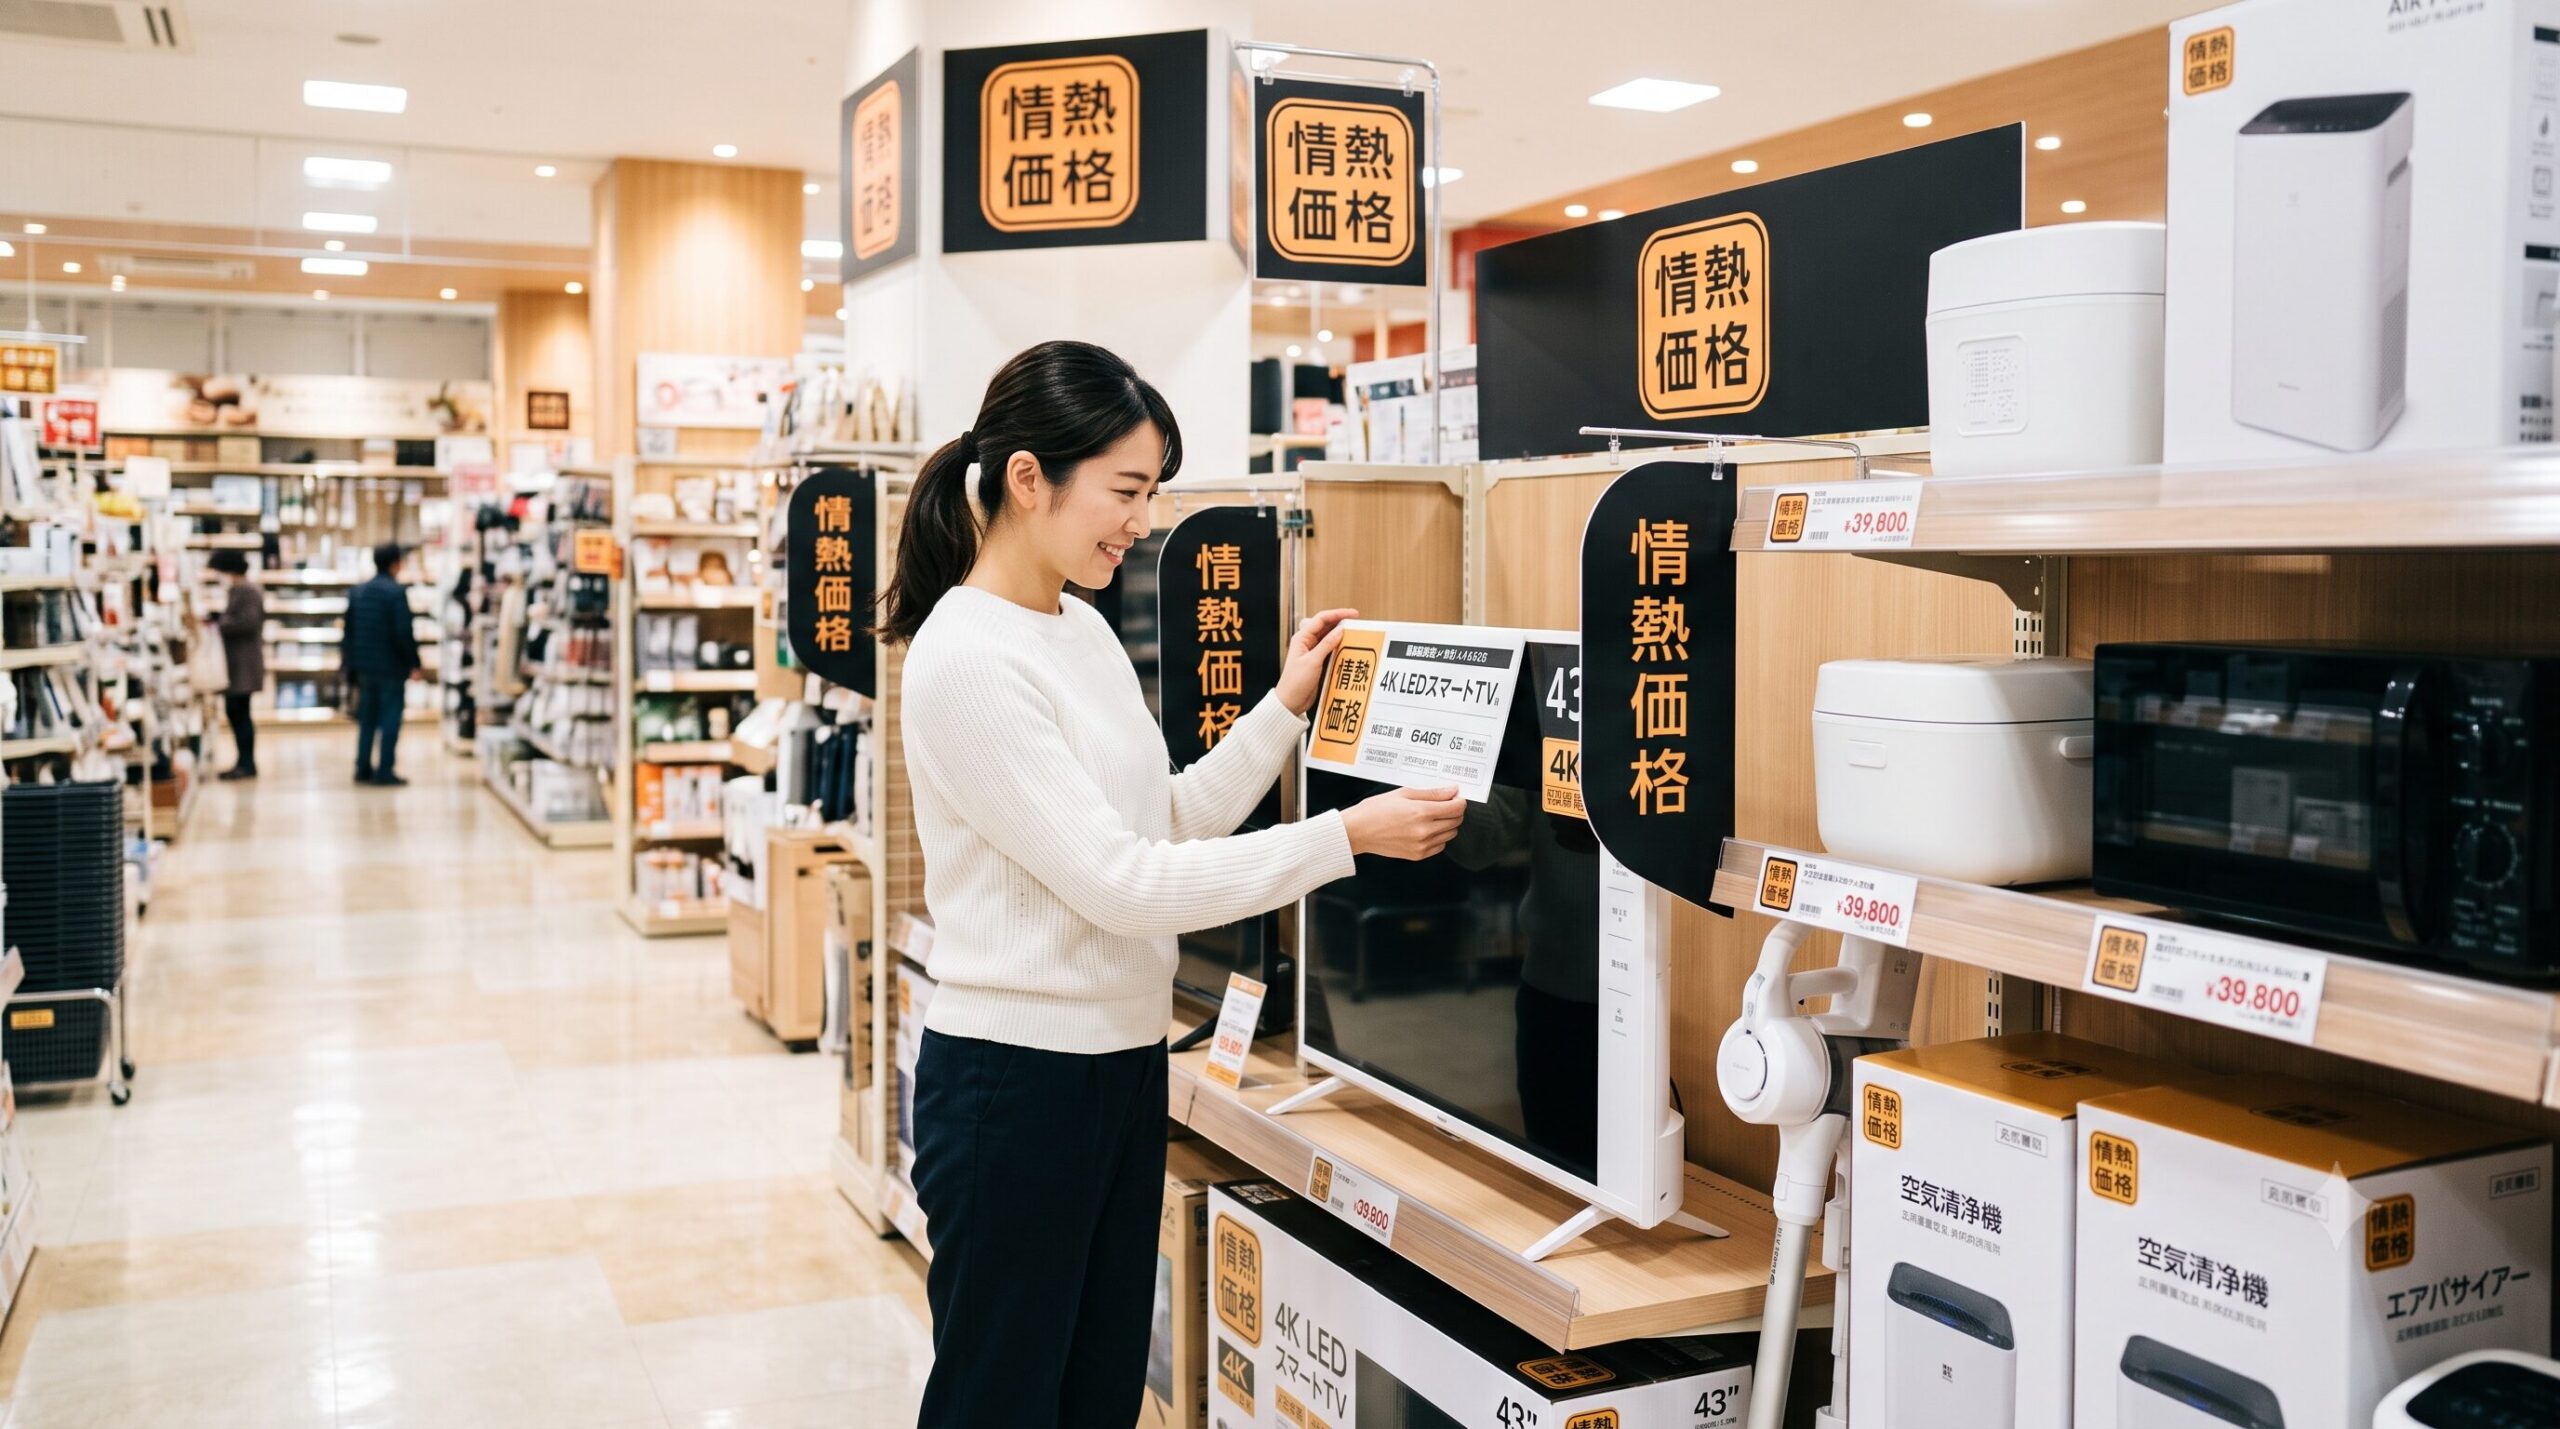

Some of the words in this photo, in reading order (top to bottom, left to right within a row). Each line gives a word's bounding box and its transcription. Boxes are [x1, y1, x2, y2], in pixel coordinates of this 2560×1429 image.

[1002, 79, 1116, 142] 情熱
[1286, 121, 1394, 180] 情熱
[1003, 149, 1116, 209] 価格
[1288, 187, 1394, 244] 価格
[1655, 244, 1750, 317] 情熱
[1656, 321, 1750, 394] 価格
[1844, 511, 1907, 534] ¥39,800
[814, 495, 852, 652] 情熱価格
[1196, 544, 1243, 749] 情熱価格
[1629, 518, 1690, 815] 情熱価格
[1335, 658, 1369, 692] 情熱
[1380, 670, 1399, 692] 4K
[1326, 697, 1363, 734] 価格
[1550, 749, 1579, 784] 4K
[1836, 894, 1900, 926] ¥39,800
[2205, 975, 2300, 1018] ¥39,800
[1867, 1089, 1898, 1119] 情熱
[1867, 1115, 1898, 1145] 価格
[2094, 1138, 2133, 1171] 情熱
[2094, 1167, 2133, 1199] 価格
[1221, 1227, 1256, 1285] 情熱
[1219, 1276, 1256, 1332] 価格
[2386, 1265, 2530, 1320] エアパサイアー
[1275, 1302, 1300, 1348] 4K
[1306, 1319, 1348, 1378] LED
[1221, 1350, 1249, 1390] 4K
[1275, 1346, 1348, 1420] スマートTV
